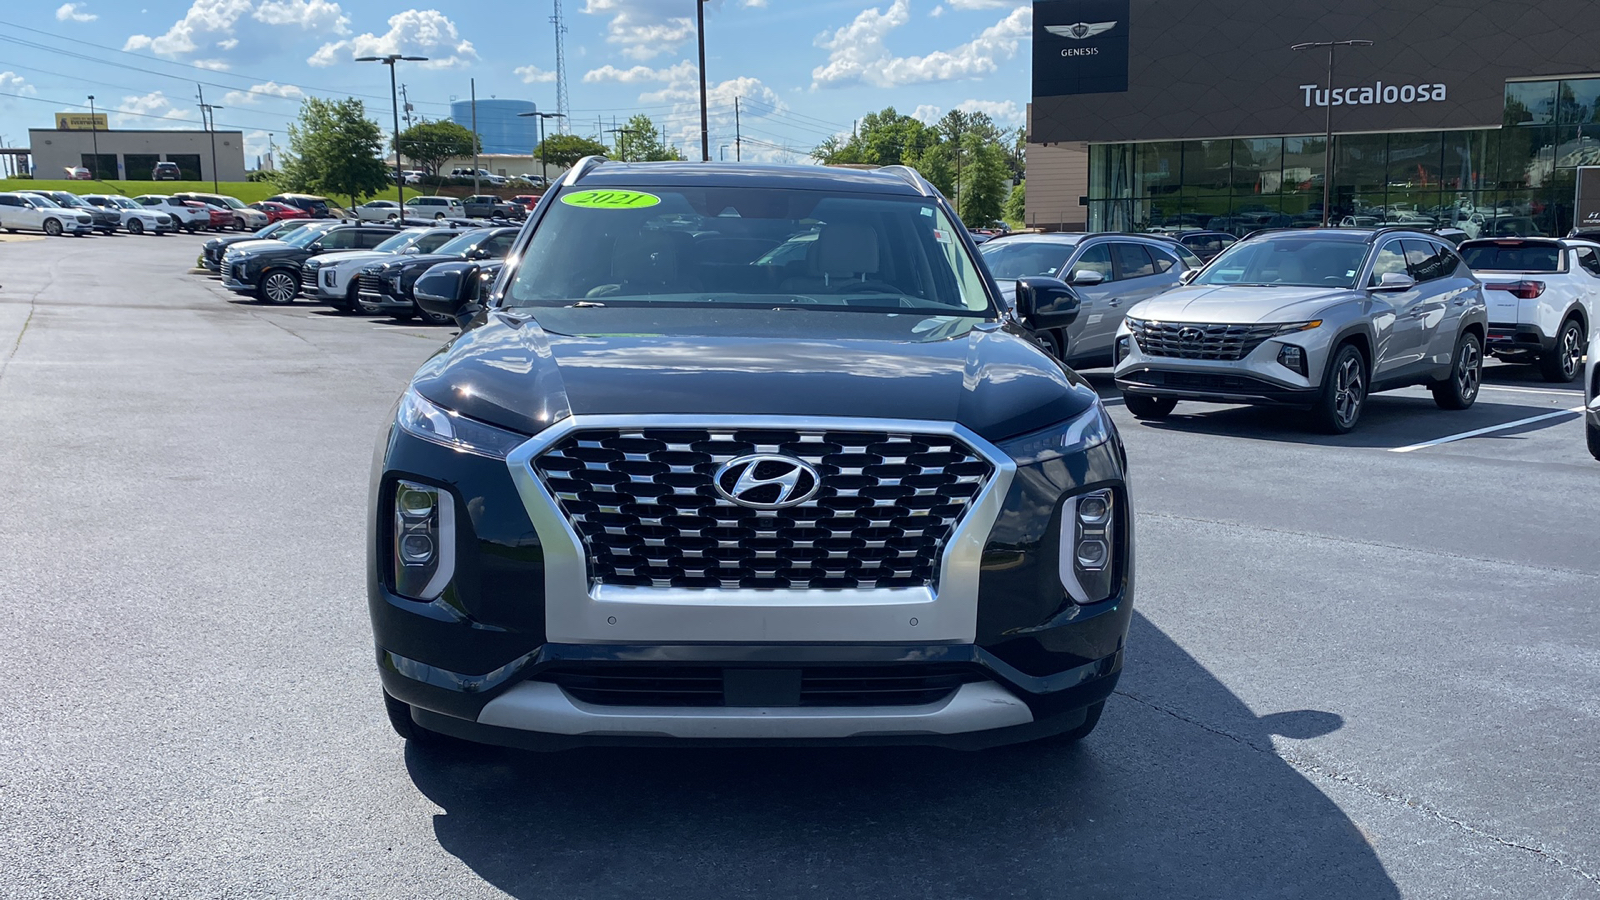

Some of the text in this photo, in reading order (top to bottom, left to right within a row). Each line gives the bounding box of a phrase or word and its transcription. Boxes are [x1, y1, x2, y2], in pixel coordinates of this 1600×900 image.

[1060, 47, 1099, 57] GENESIS
[1299, 81, 1447, 107] Tuscaloosa
[574, 192, 646, 205] 2021
